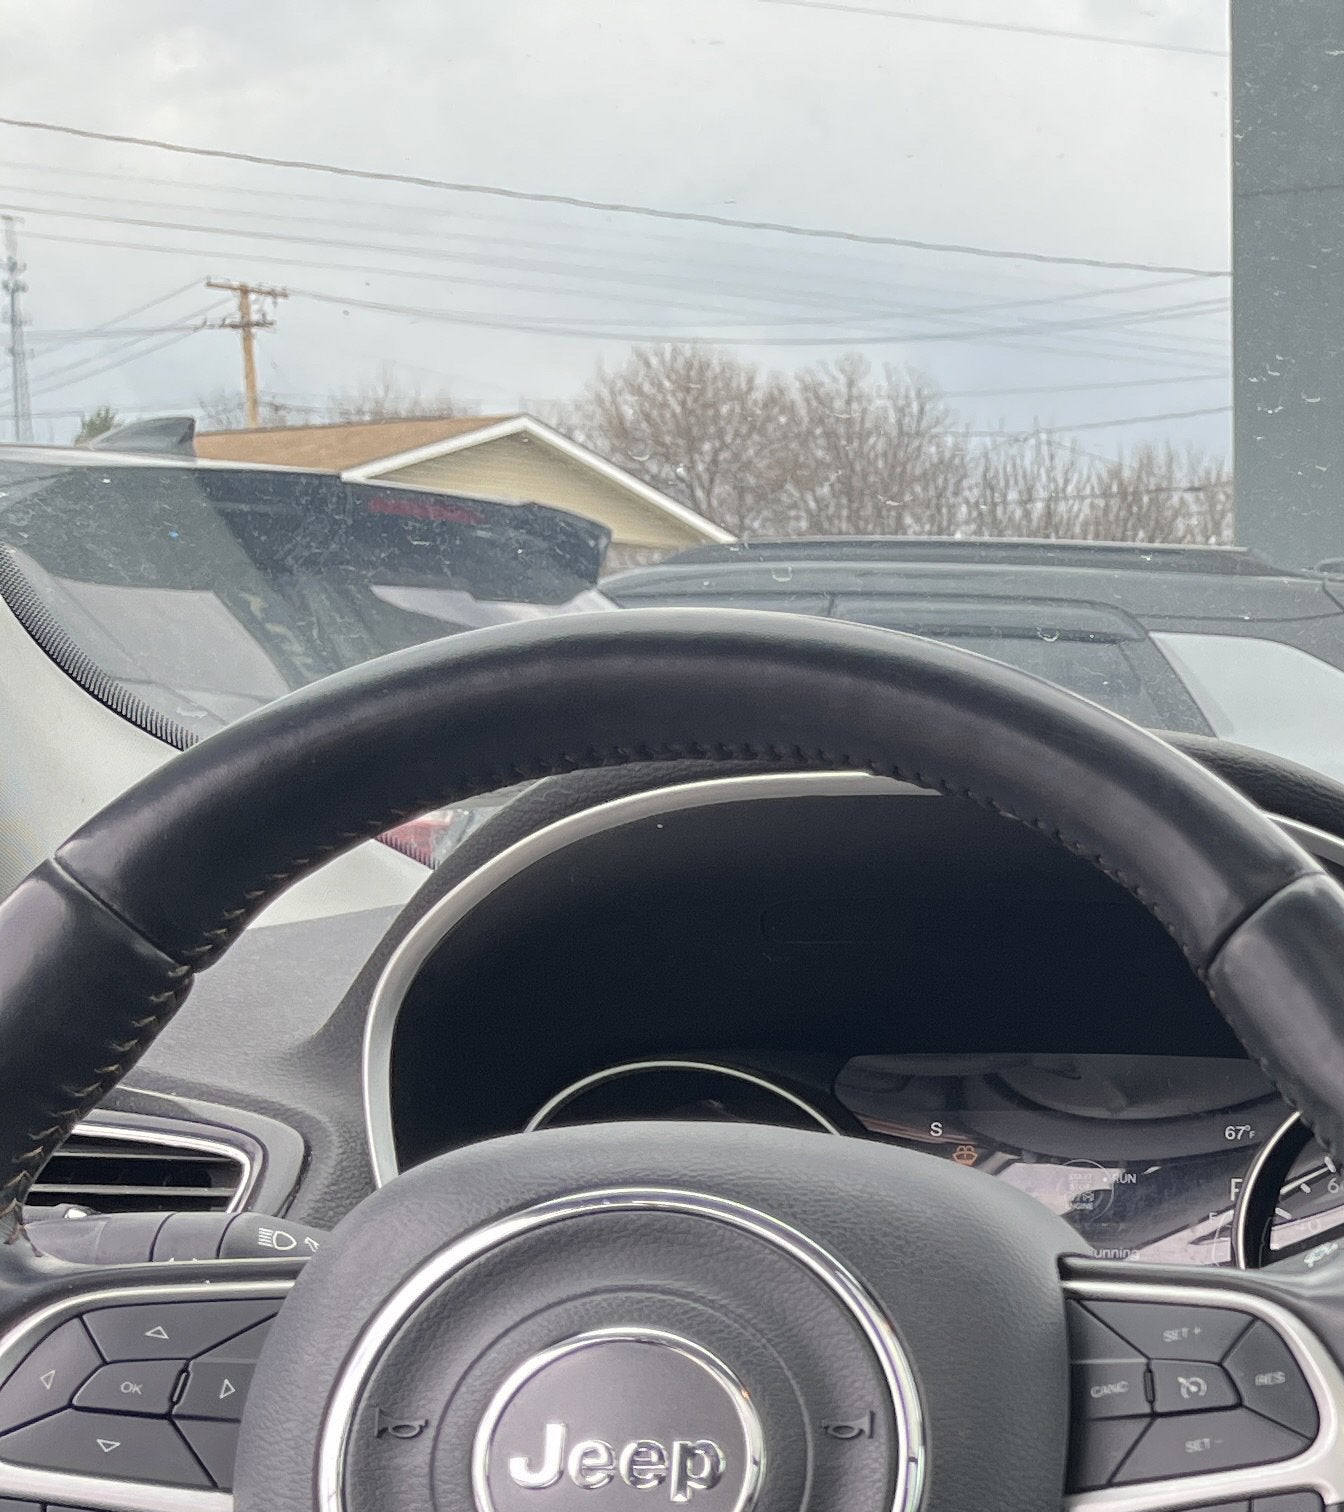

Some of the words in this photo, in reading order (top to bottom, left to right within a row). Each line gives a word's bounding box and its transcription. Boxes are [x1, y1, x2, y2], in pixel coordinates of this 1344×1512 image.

[930, 1121, 943, 1137] S
[120, 1380, 143, 1396] OK
[508, 1422, 726, 1504] Jeep
